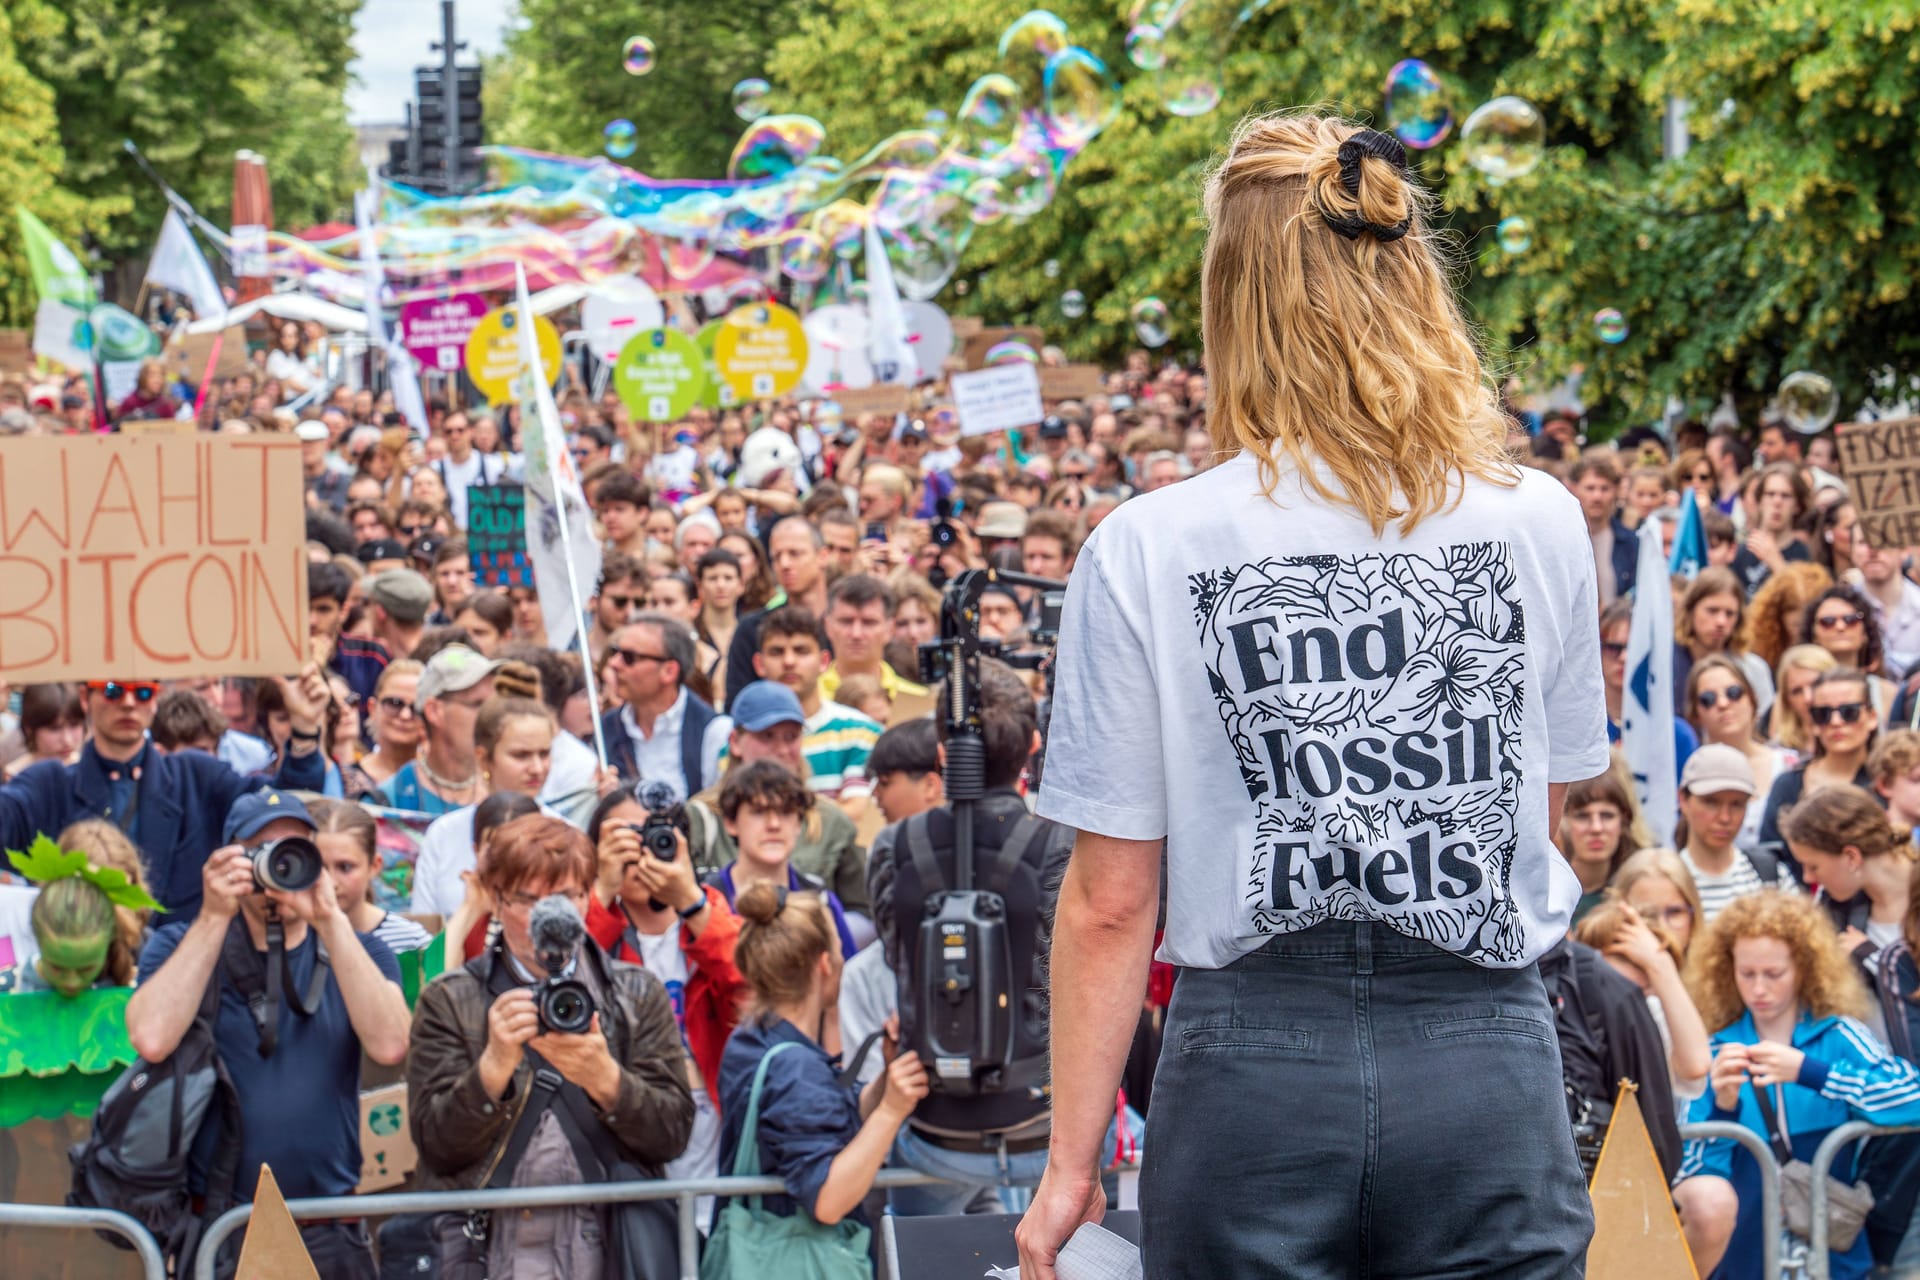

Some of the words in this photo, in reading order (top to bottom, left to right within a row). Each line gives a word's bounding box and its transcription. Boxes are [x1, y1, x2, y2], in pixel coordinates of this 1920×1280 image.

[0, 547, 303, 671] BITCOIN
[1226, 607, 1407, 694] End
[1258, 710, 1494, 799] Fossil
[1271, 831, 1484, 911] Fuels
